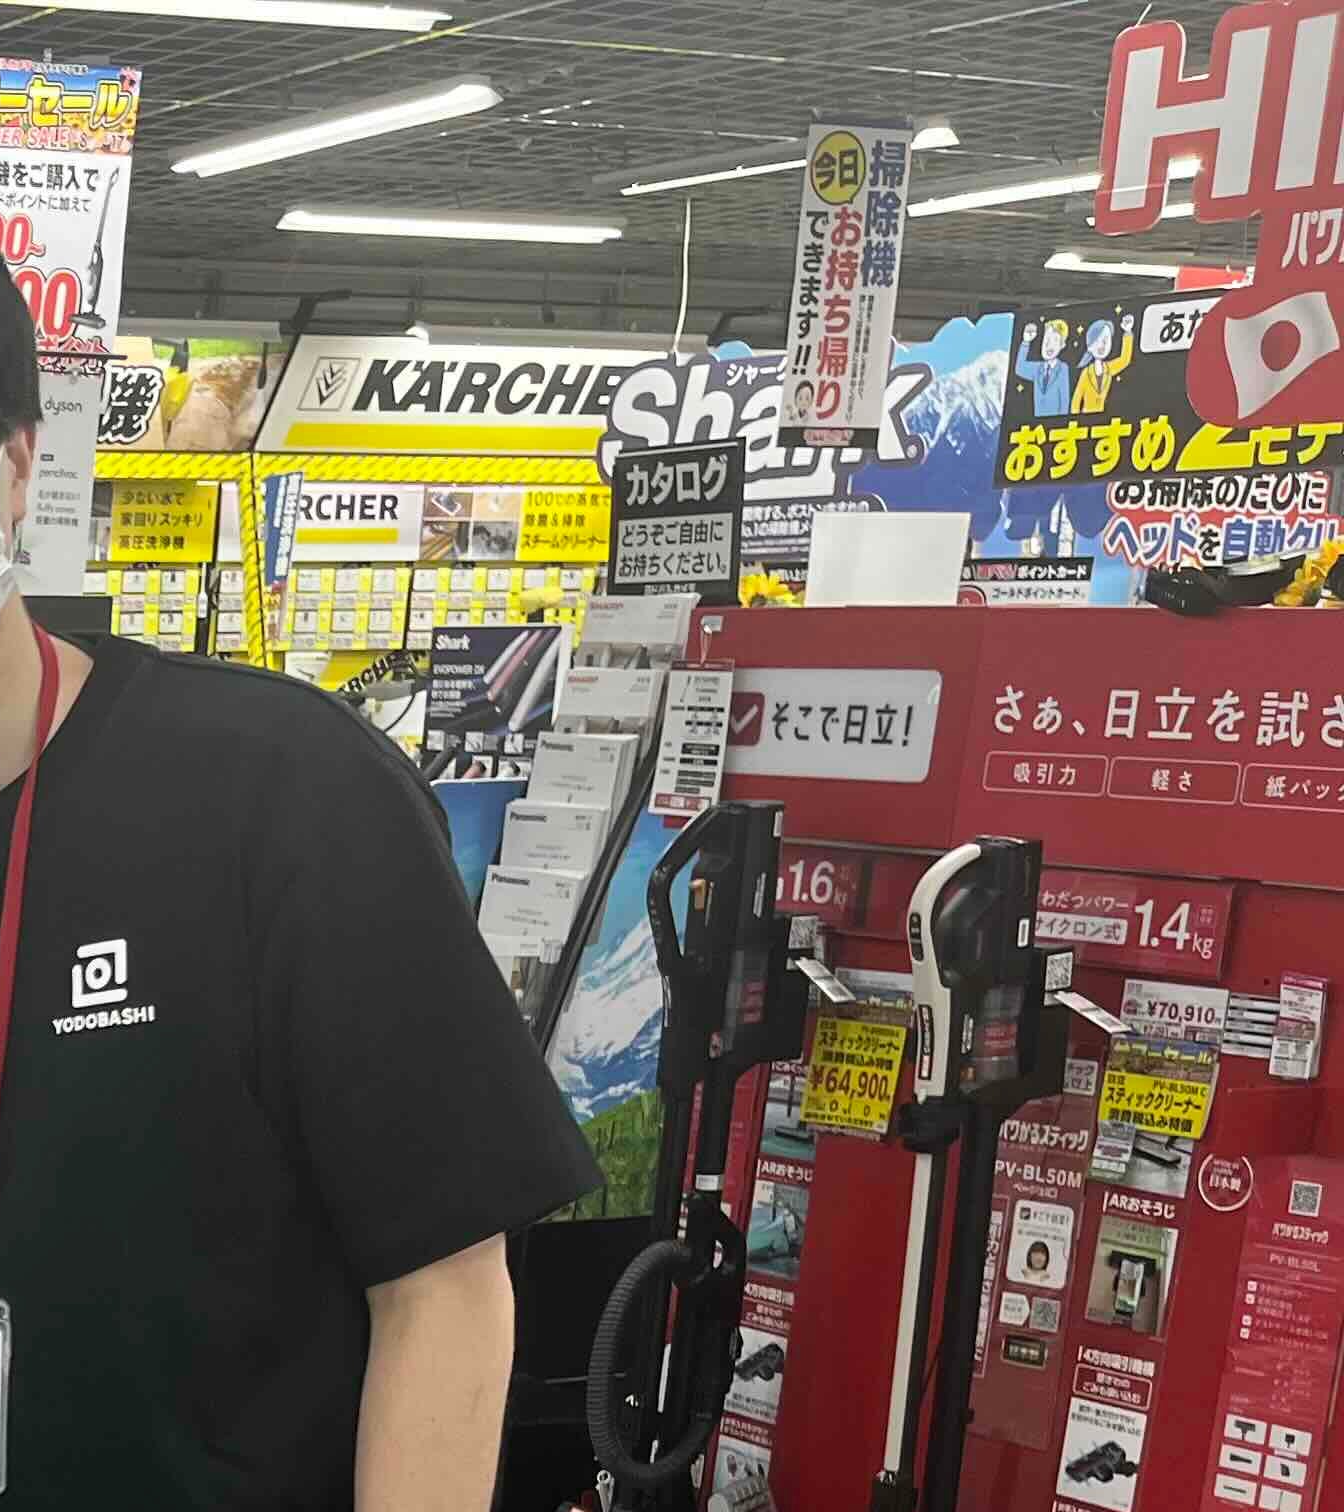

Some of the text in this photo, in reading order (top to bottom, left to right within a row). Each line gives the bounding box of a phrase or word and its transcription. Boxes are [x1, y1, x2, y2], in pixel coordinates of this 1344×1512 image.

[814, 150, 863, 189] 今日
[861, 140, 906, 289] 掃除機
[814, 206, 863, 420] お持ち帰り
[625, 454, 728, 506] カタログ
[621, 519, 725, 548] どうぞご自由に
[618, 548, 729, 578] お持ちください。
[770, 702, 915, 748] そこで日立!
[1013, 760, 1194, 792] 吸引力 軽さ
[52, 1004, 156, 1034] YODOBASHI
[1104, 1086, 1202, 1113] スティッククリーナー
[994, 1159, 1082, 1189] PV-BL50M
